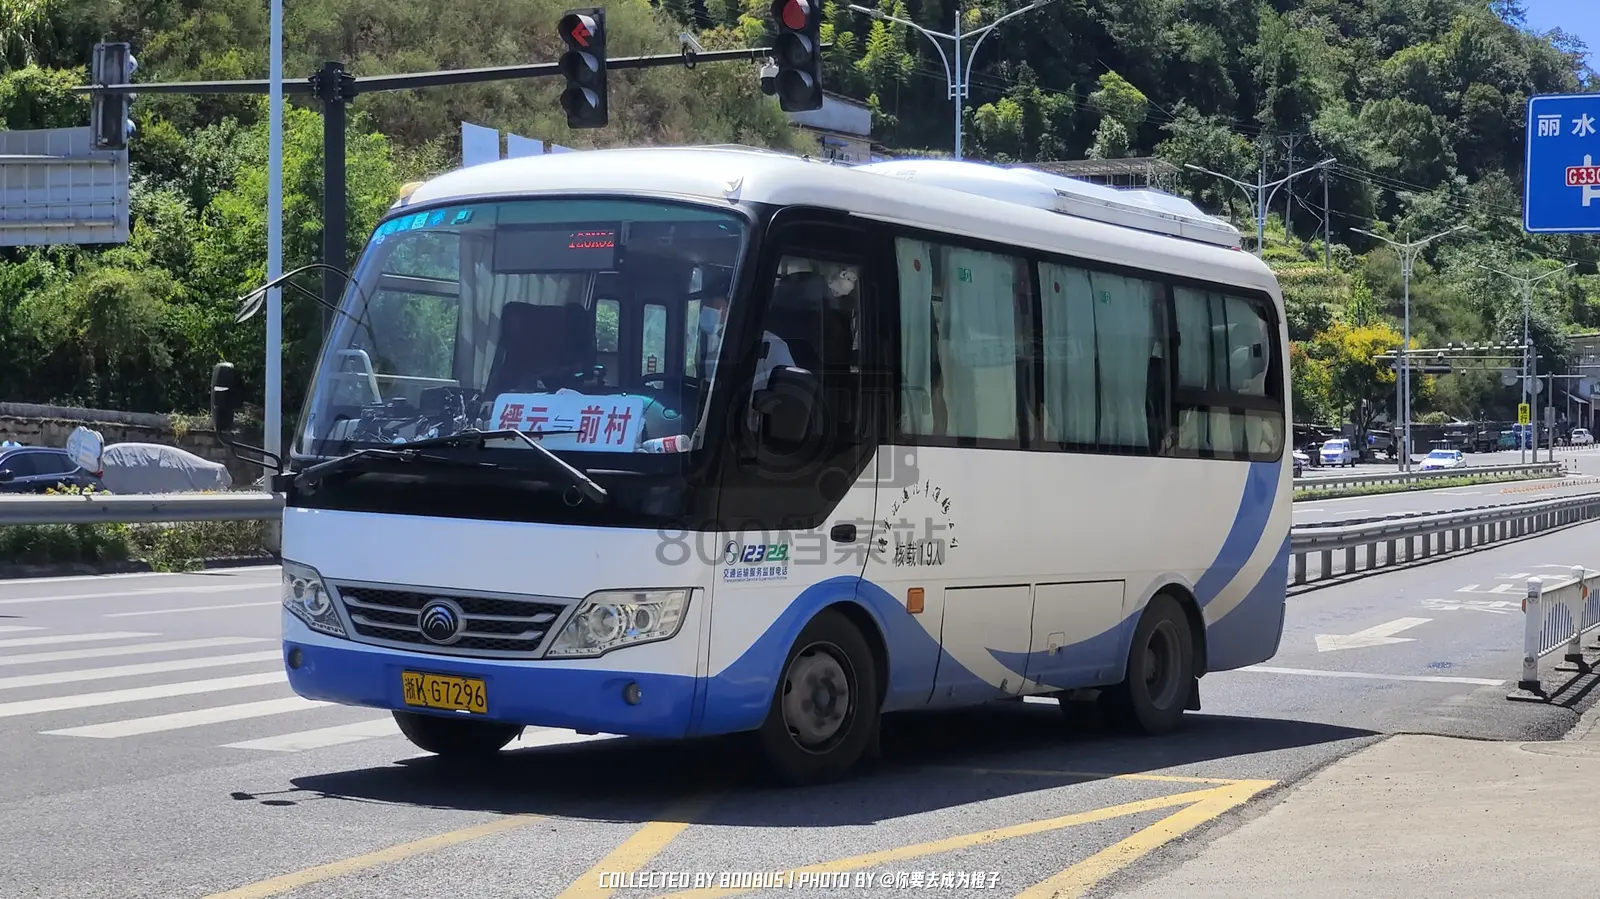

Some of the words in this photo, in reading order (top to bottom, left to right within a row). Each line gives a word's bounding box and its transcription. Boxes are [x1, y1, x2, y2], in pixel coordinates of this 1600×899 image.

[1537, 113, 1596, 137] 丽水
[576, 405, 631, 445] 前村
[893, 541, 942, 567] 核载19人
[723, 566, 788, 579] 交通运输服务监督电话
